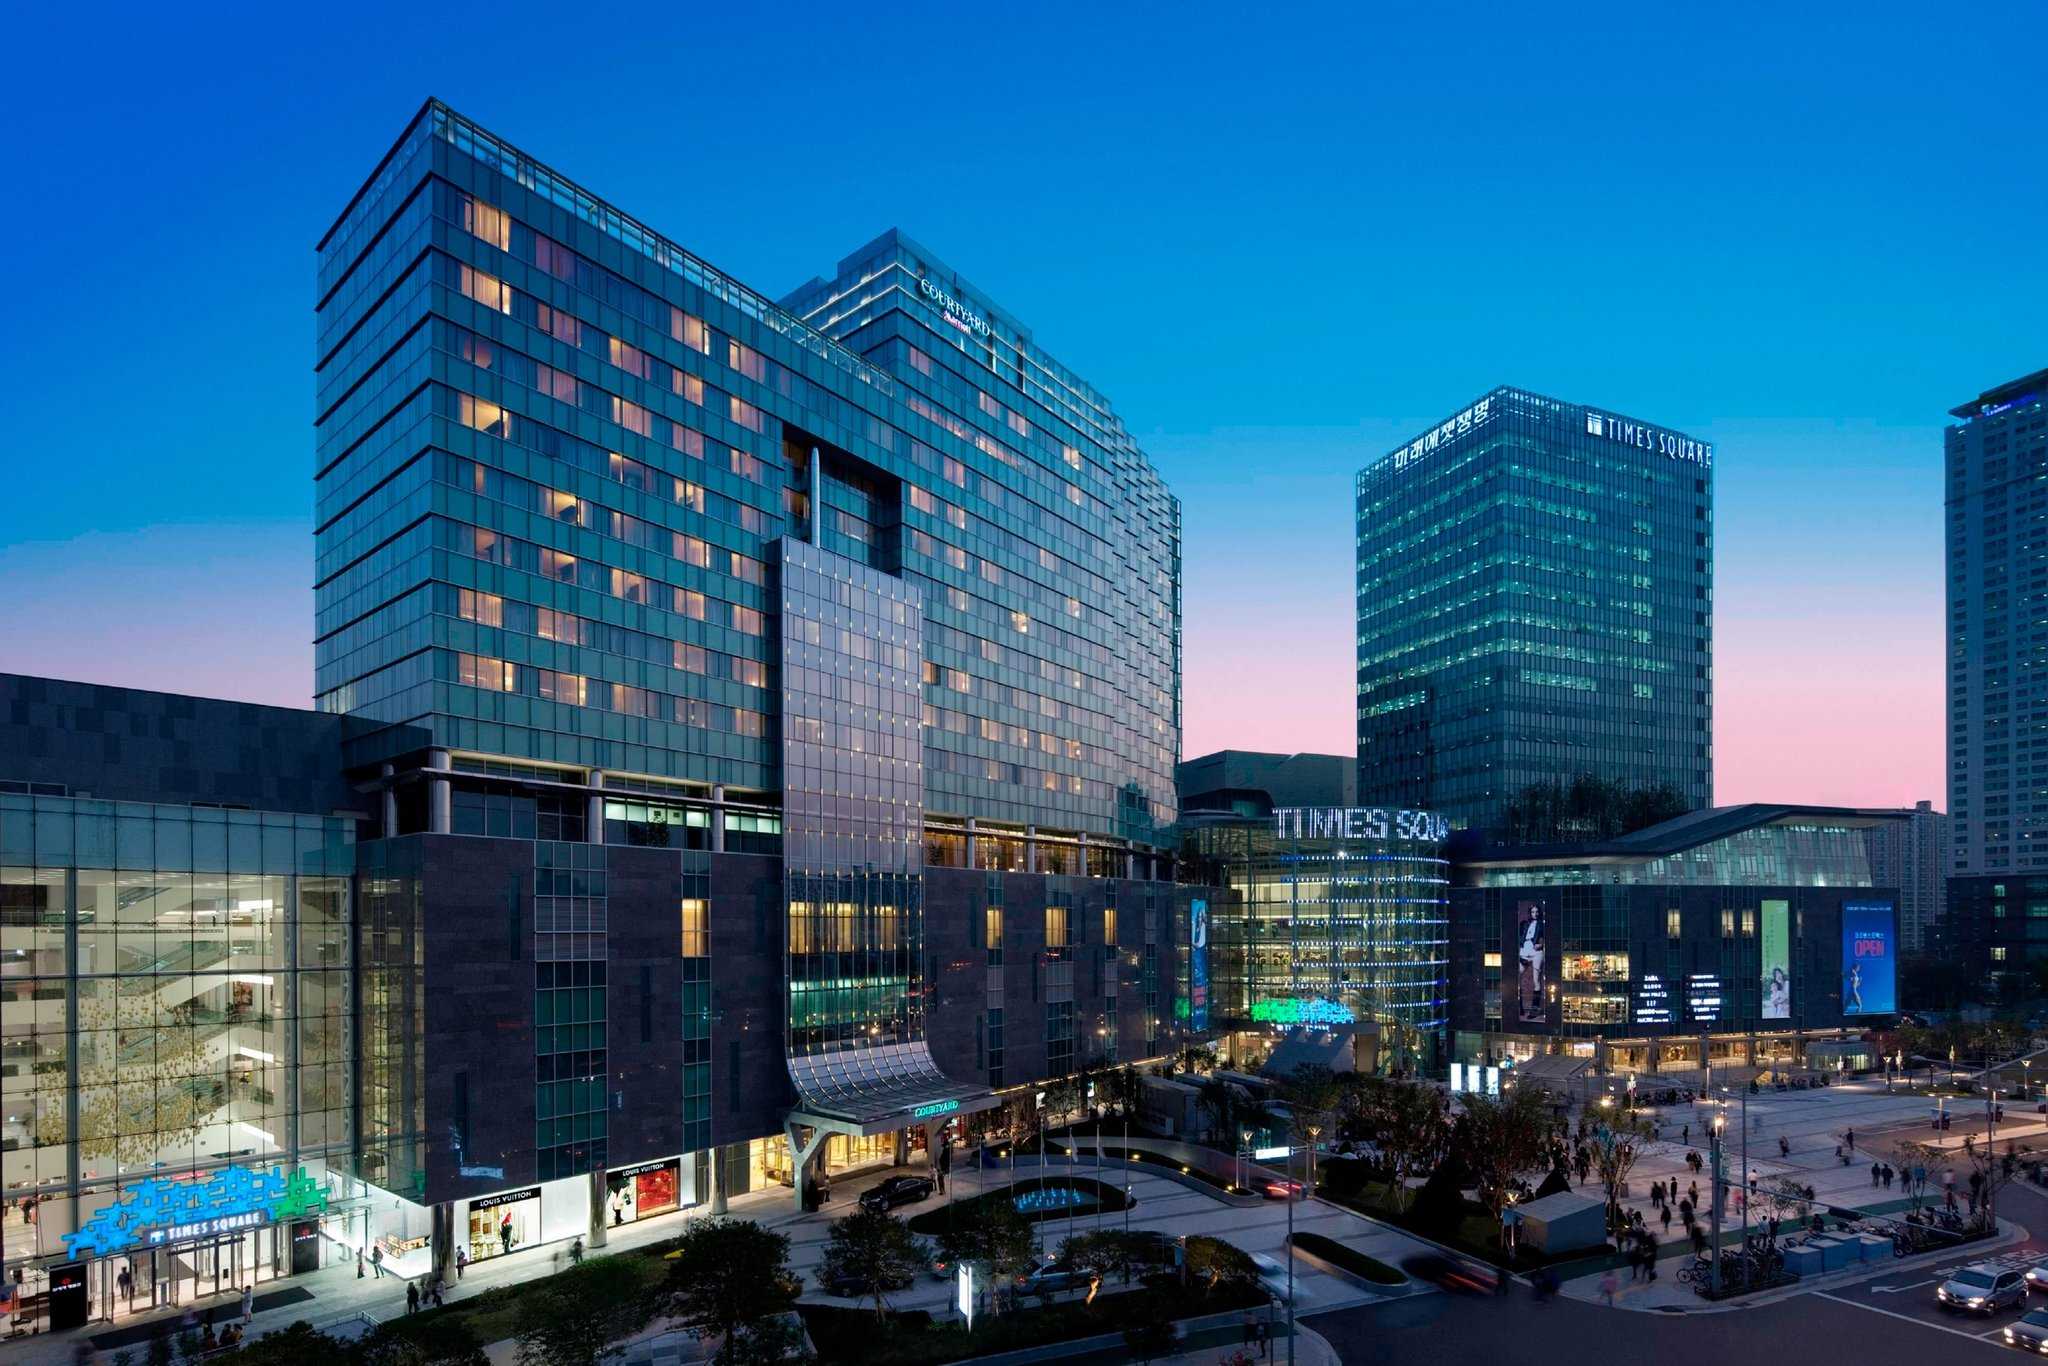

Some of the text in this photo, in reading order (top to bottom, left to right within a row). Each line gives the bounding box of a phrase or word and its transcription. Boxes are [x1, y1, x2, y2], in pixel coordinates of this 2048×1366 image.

[921, 278, 990, 337] COURTYARD
[1393, 397, 1490, 469] 미래에셋생명
[1608, 418, 1712, 465] TIMES SQUARE
[1272, 808, 1388, 839] TIMES
[1855, 940, 1884, 957] OPEN
[915, 1100, 959, 1117] COURTYARD
[622, 1163, 664, 1177] LOUIS VUITTON
[480, 1191, 532, 1207] LOUIS VUITTON
[168, 1212, 260, 1240] TIMES SQUARE
